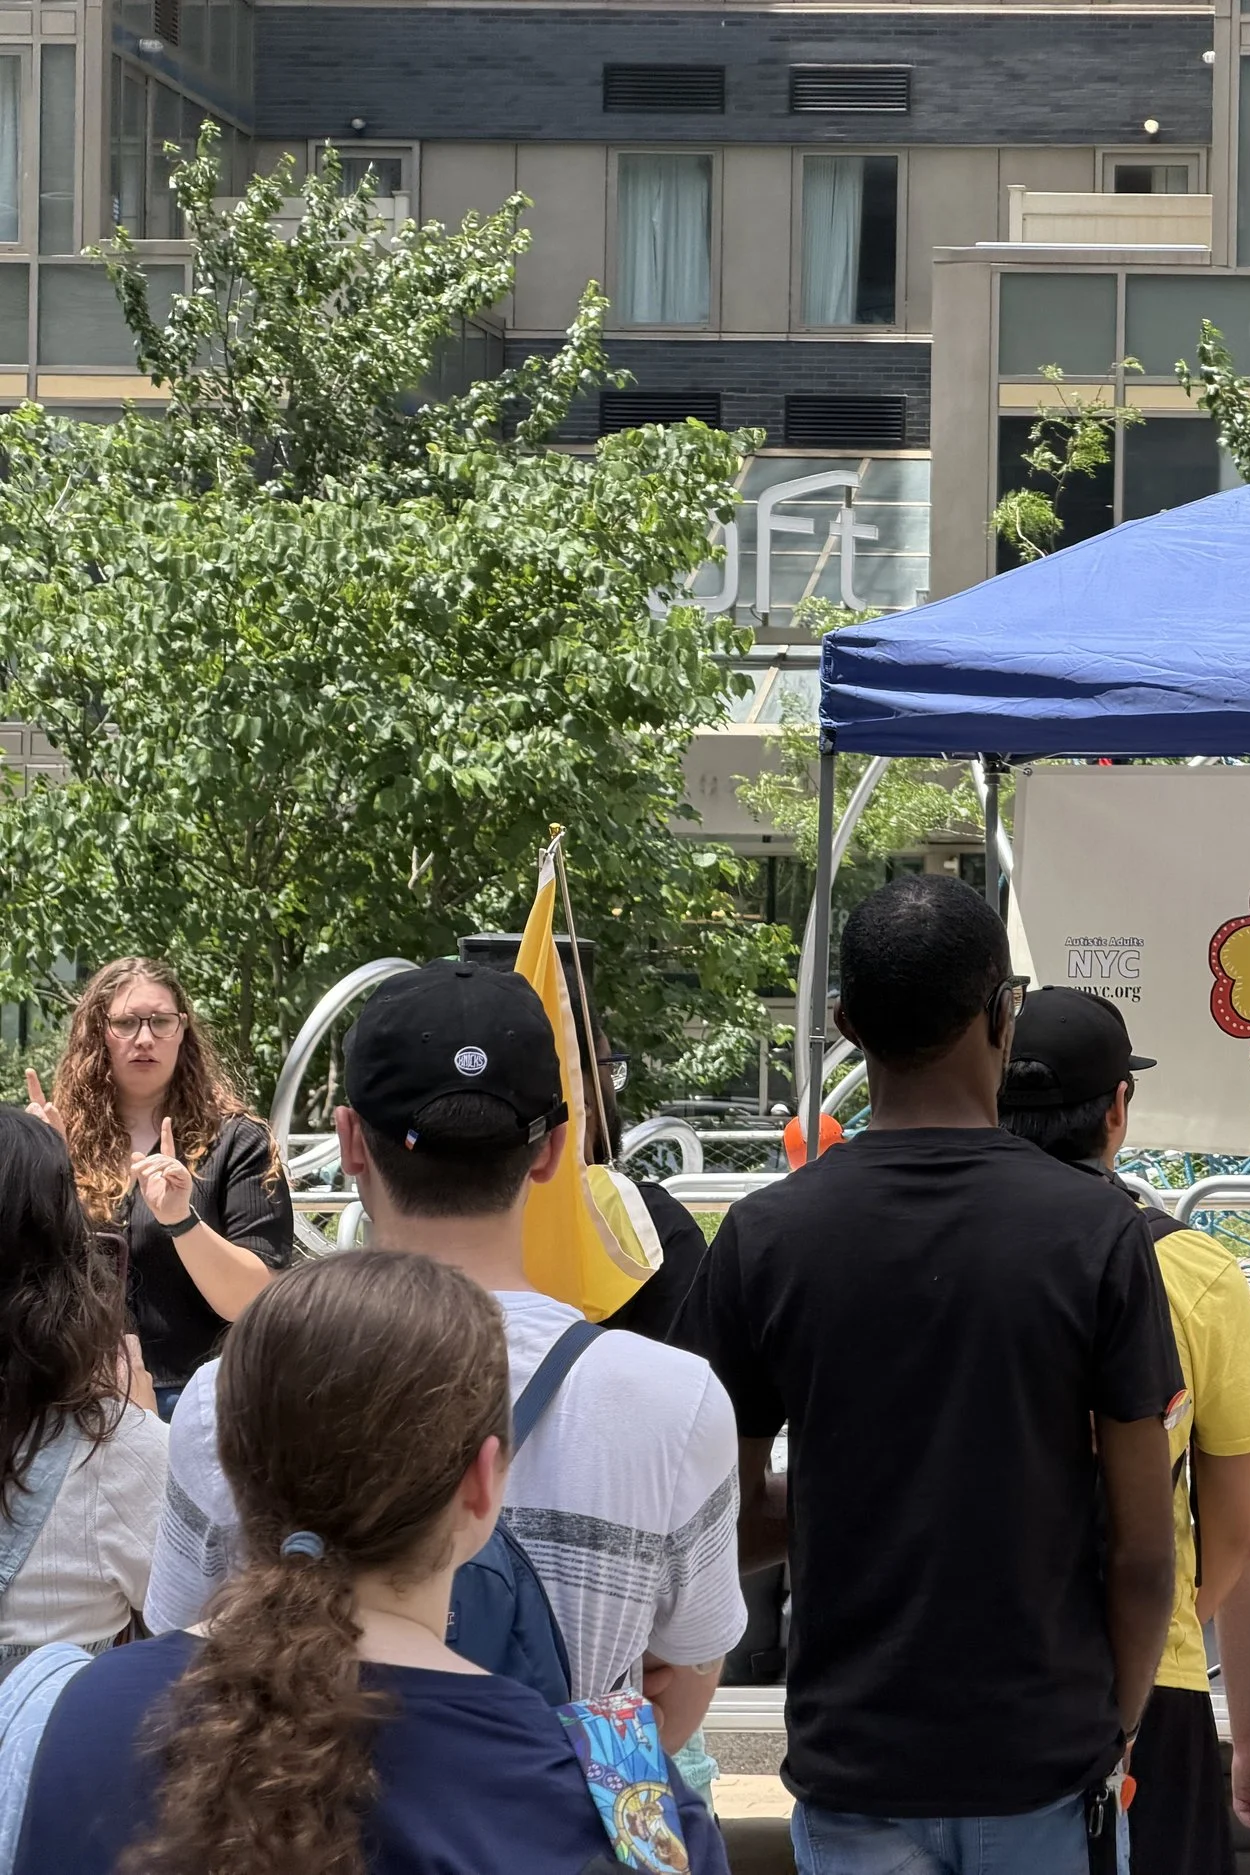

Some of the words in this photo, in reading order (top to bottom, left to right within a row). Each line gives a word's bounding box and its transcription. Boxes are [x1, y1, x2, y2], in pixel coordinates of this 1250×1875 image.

[1065, 936, 1107, 946] Autistic
[1108, 936, 1144, 946] Adults
[1068, 949, 1140, 978] NYC
[458, 1054, 485, 1068] KNICKS
